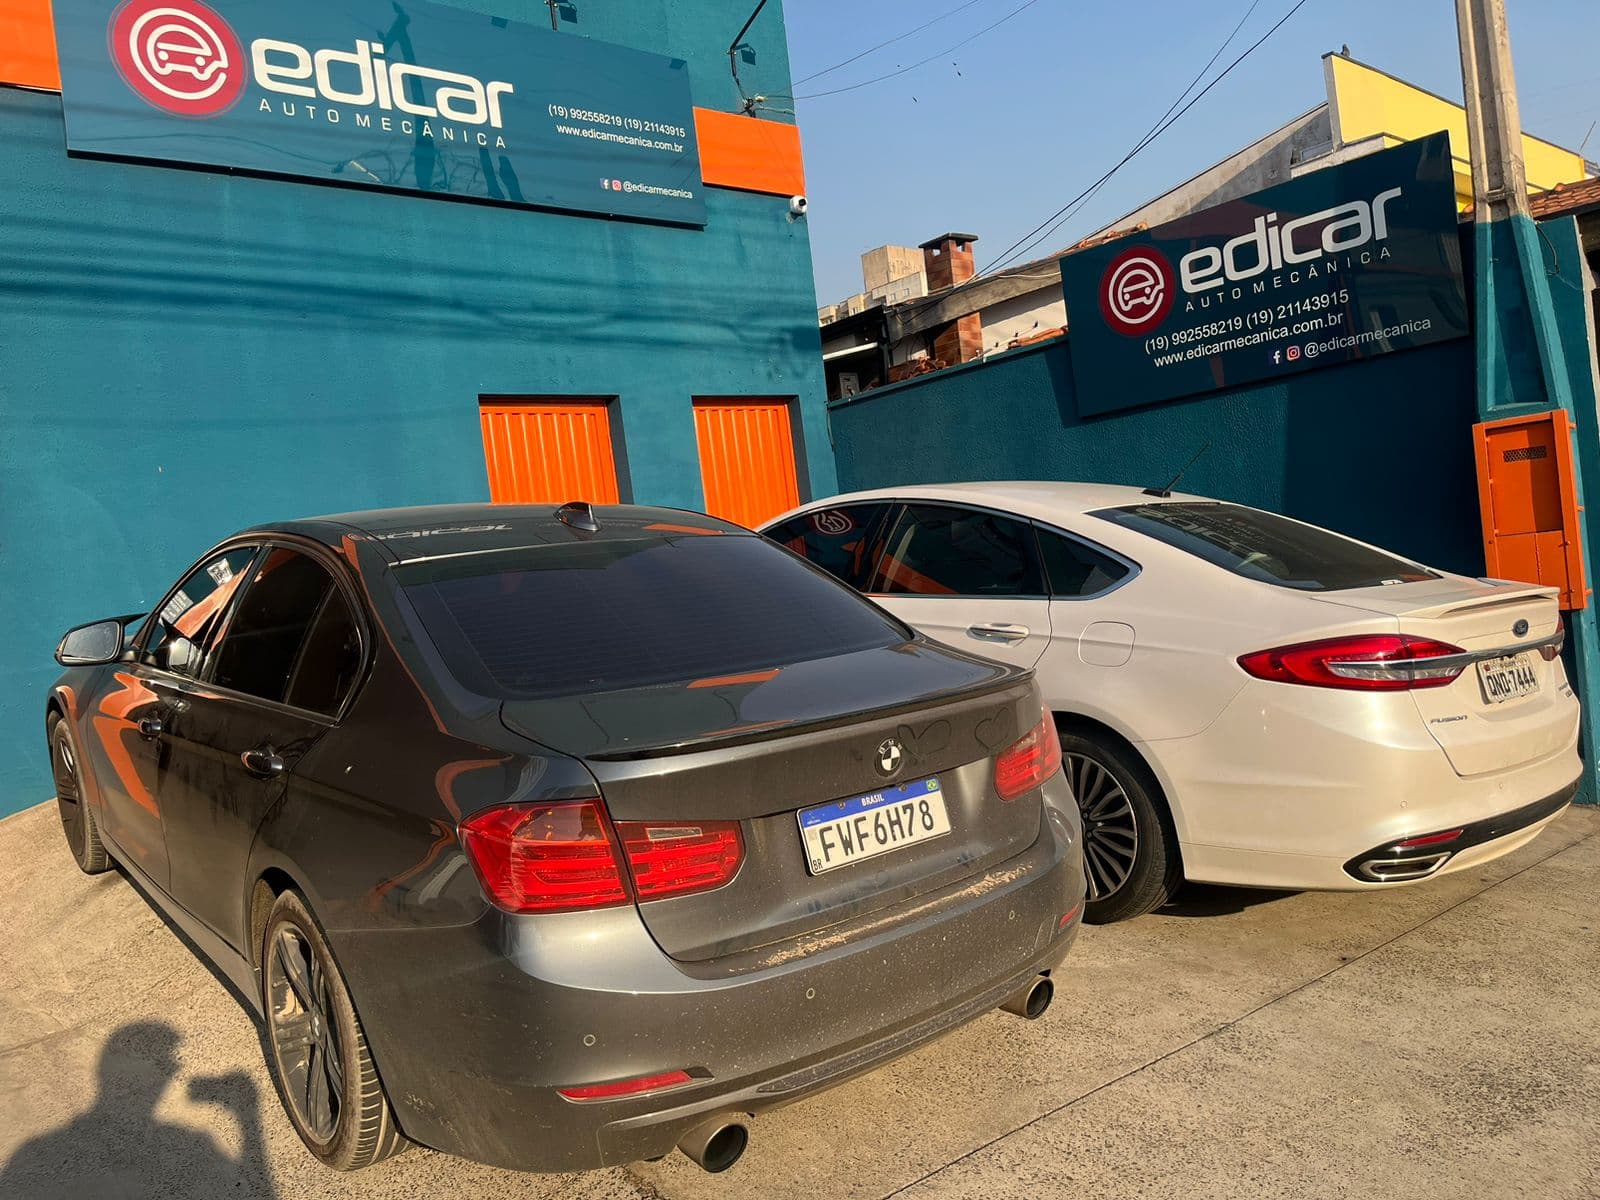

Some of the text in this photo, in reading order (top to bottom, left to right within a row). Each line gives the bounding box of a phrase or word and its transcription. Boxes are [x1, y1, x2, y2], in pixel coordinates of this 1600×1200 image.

[251, 38, 514, 129] edicar
[259, 98, 506, 149] AUTO MECÂNICA
[548, 103, 686, 138] (19) 992558219 (19) 21143915
[556, 124, 683, 153] www.edicarmecanica.com.br
[622, 181, 693, 199] @edicarmecanica
[1179, 186, 1402, 295] edicar
[1185, 246, 1391, 313] AUTO MECÂNICA
[1145, 288, 1349, 355] (19) 992558219 (19) 21143915
[1153, 312, 1344, 368] www.edicarmecanica.com.br
[1304, 318, 1431, 358] @edicarmecanica
[861, 793, 885, 807] BRASIL
[818, 799, 935, 863] FWF6H78
[812, 858, 823, 871] BR
